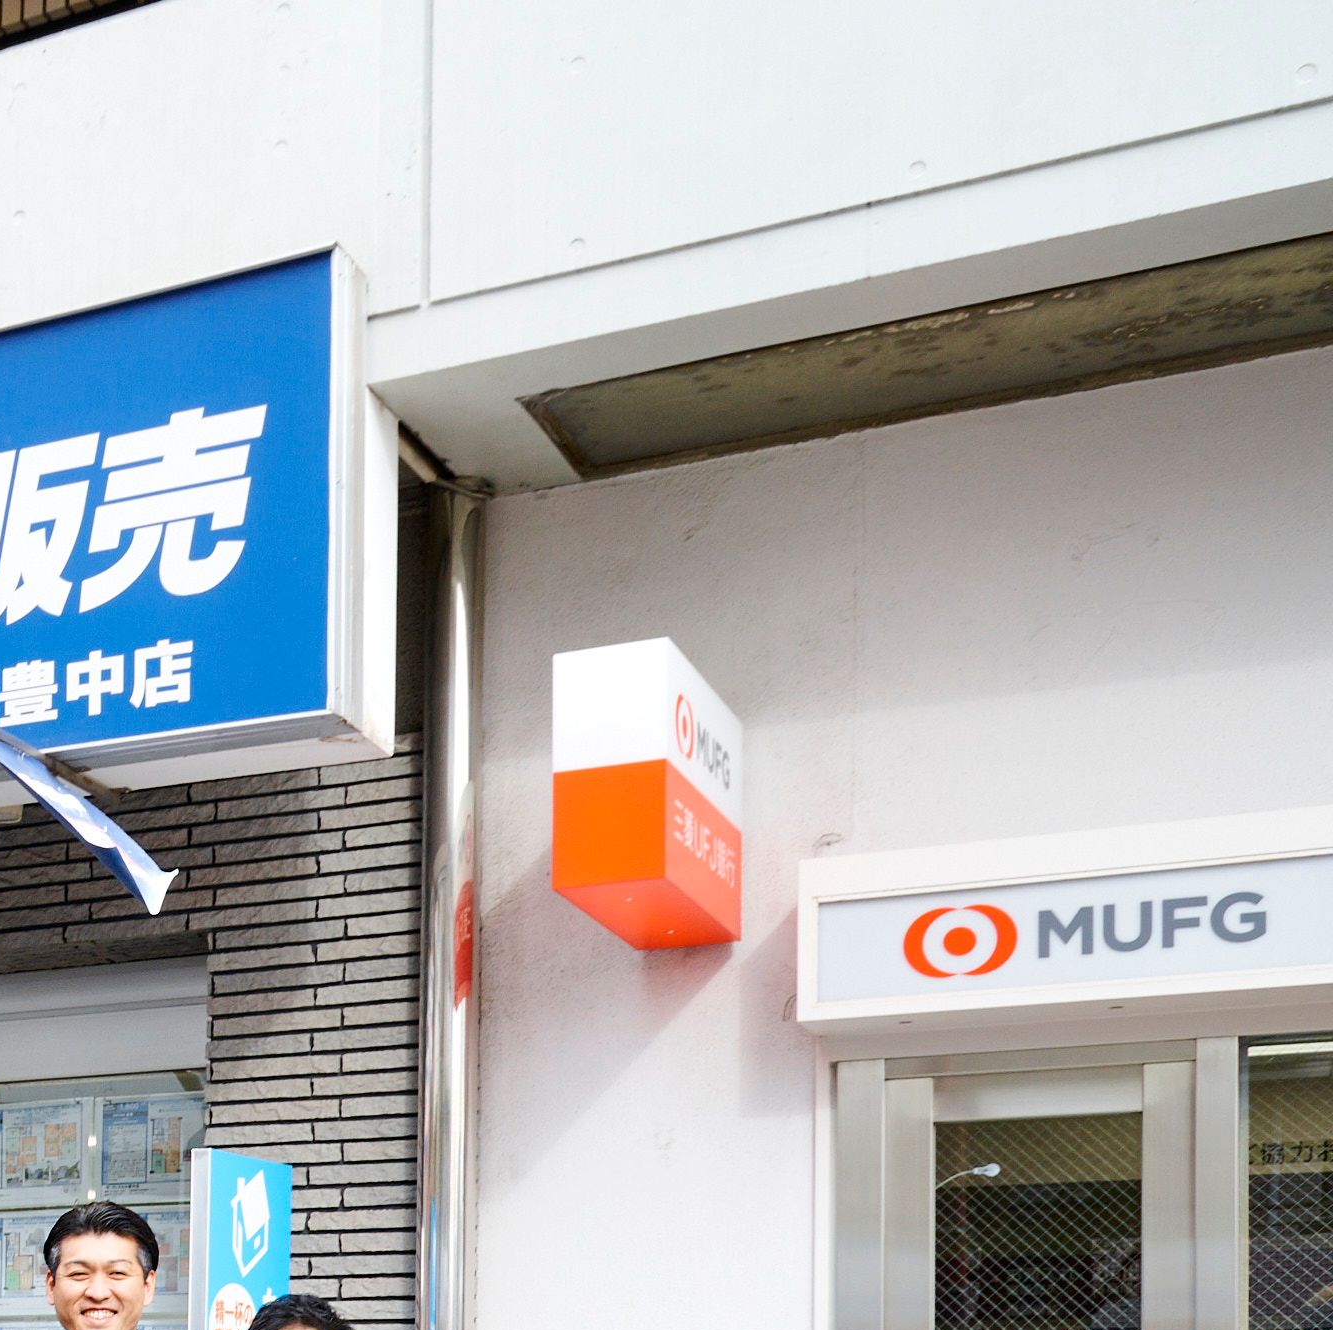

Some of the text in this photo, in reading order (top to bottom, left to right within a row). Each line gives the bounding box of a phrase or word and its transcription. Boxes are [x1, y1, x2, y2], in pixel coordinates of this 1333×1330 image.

[696, 721, 731, 790] MUFG
[1038, 891, 1268, 960] MUFG
[214, 1298, 254, 1326] 精一杯の
